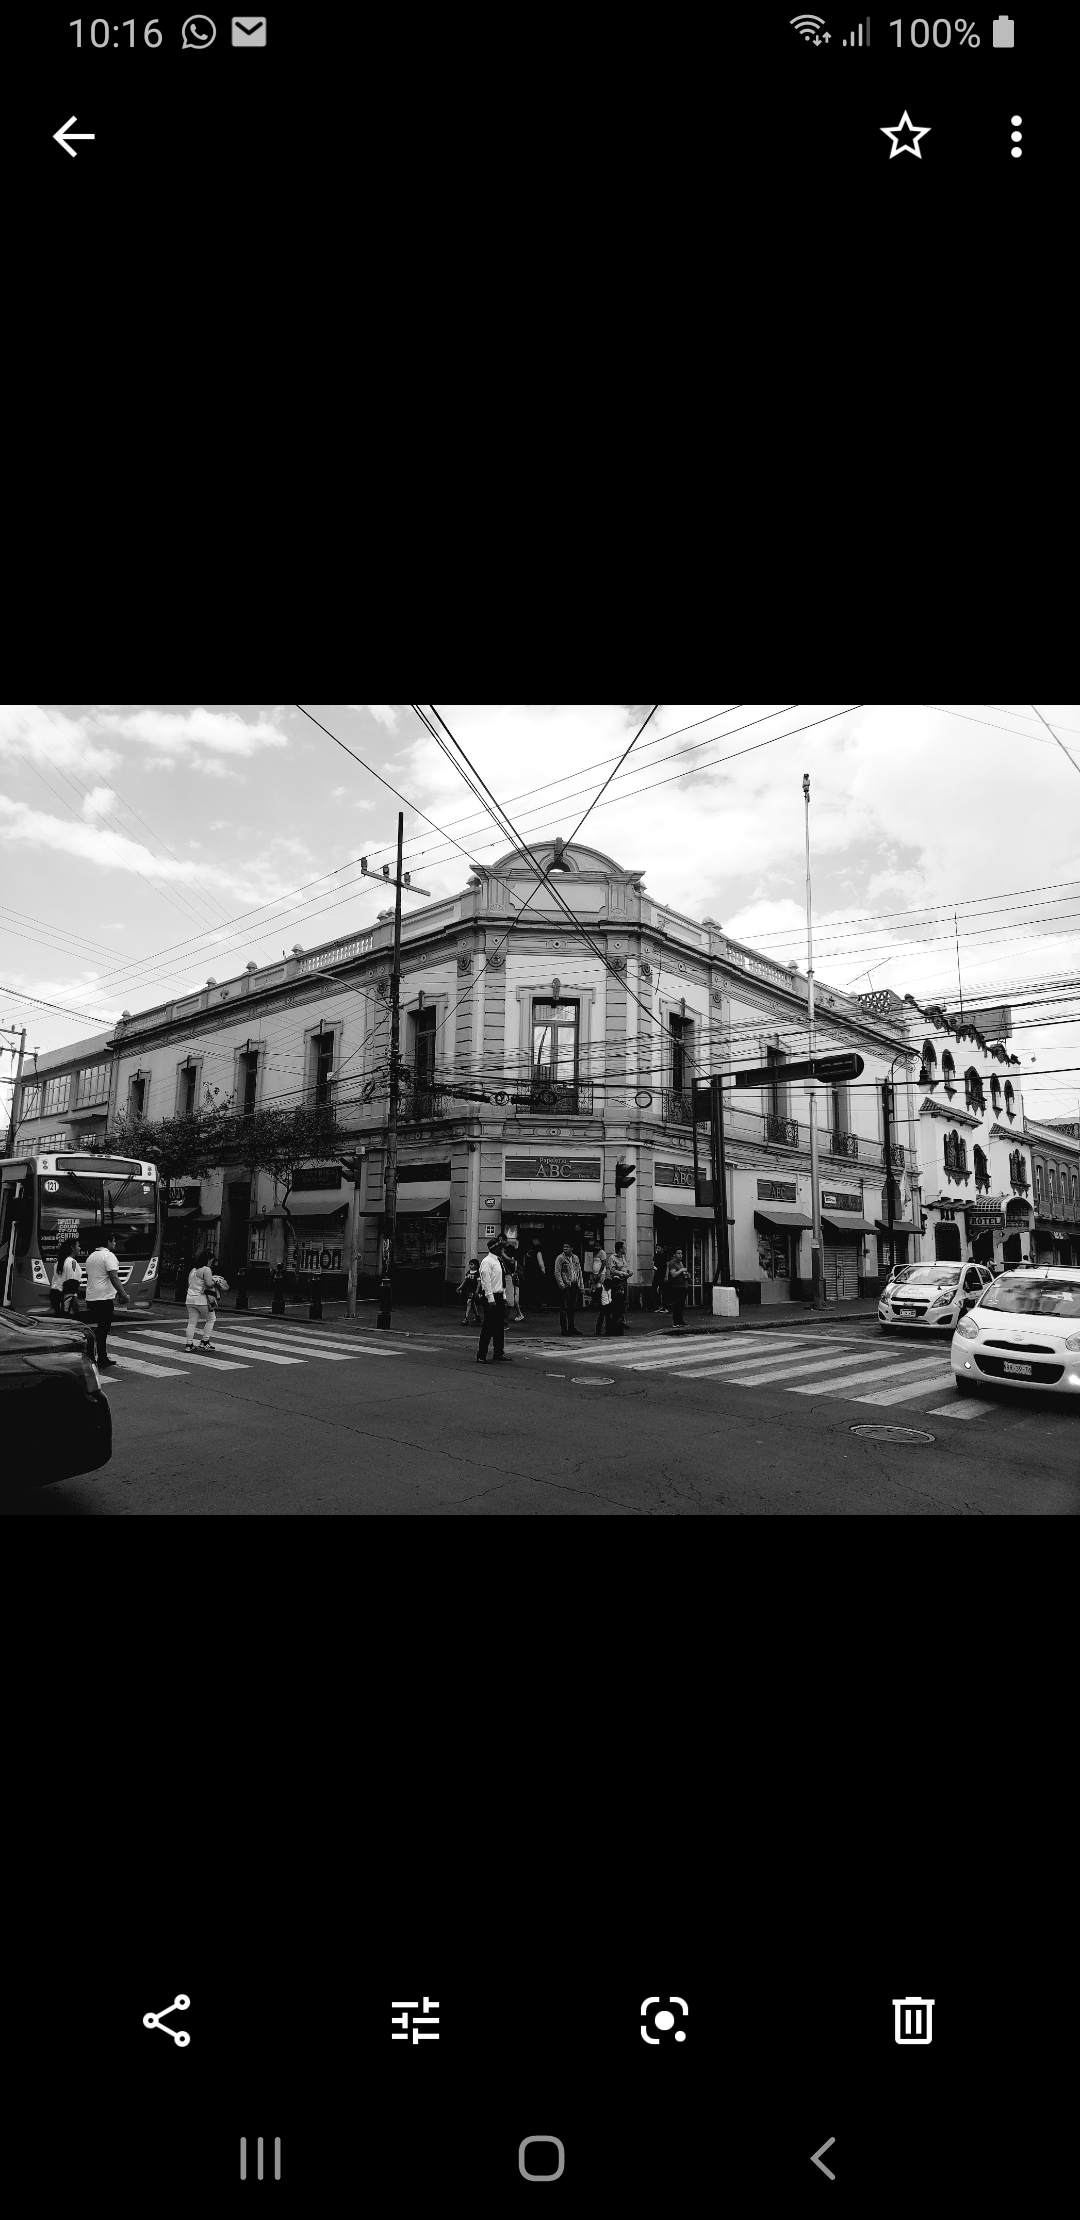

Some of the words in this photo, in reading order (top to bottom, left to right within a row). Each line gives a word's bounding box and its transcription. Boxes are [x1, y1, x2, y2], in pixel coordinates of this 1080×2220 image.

[535, 1163, 572, 1178] ABC
[673, 1172, 693, 1186] ABC
[47, 1181, 57, 1191] 121
[971, 1217, 1001, 1225] HOTEL
